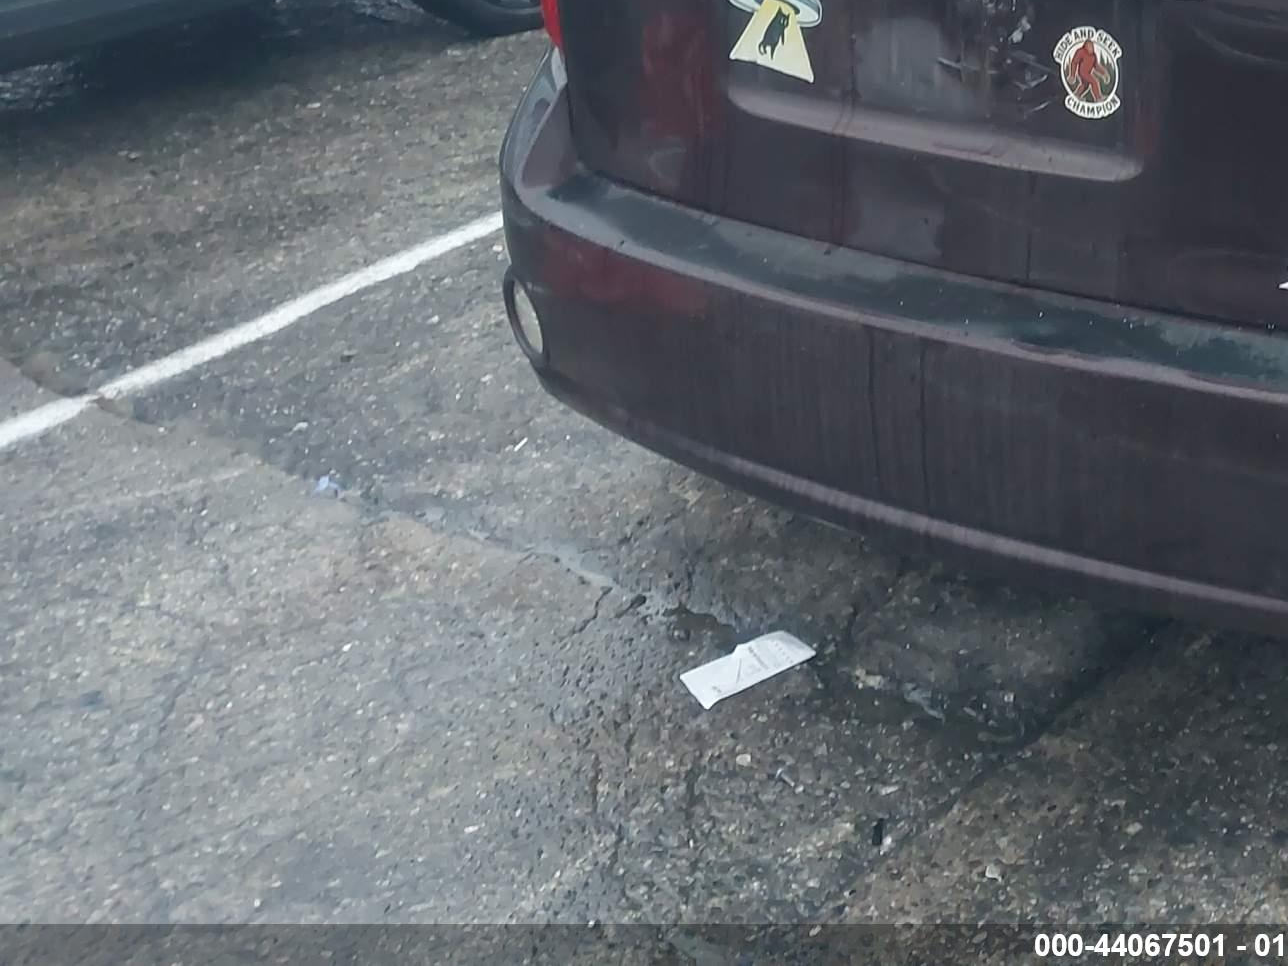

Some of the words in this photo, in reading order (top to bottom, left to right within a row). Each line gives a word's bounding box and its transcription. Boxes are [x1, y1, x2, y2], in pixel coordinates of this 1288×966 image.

[1054, 34, 1073, 62] HIDE
[1073, 28, 1095, 41] AND
[1096, 31, 1121, 59] SEEK
[1066, 96, 1119, 117] CHAMPION
